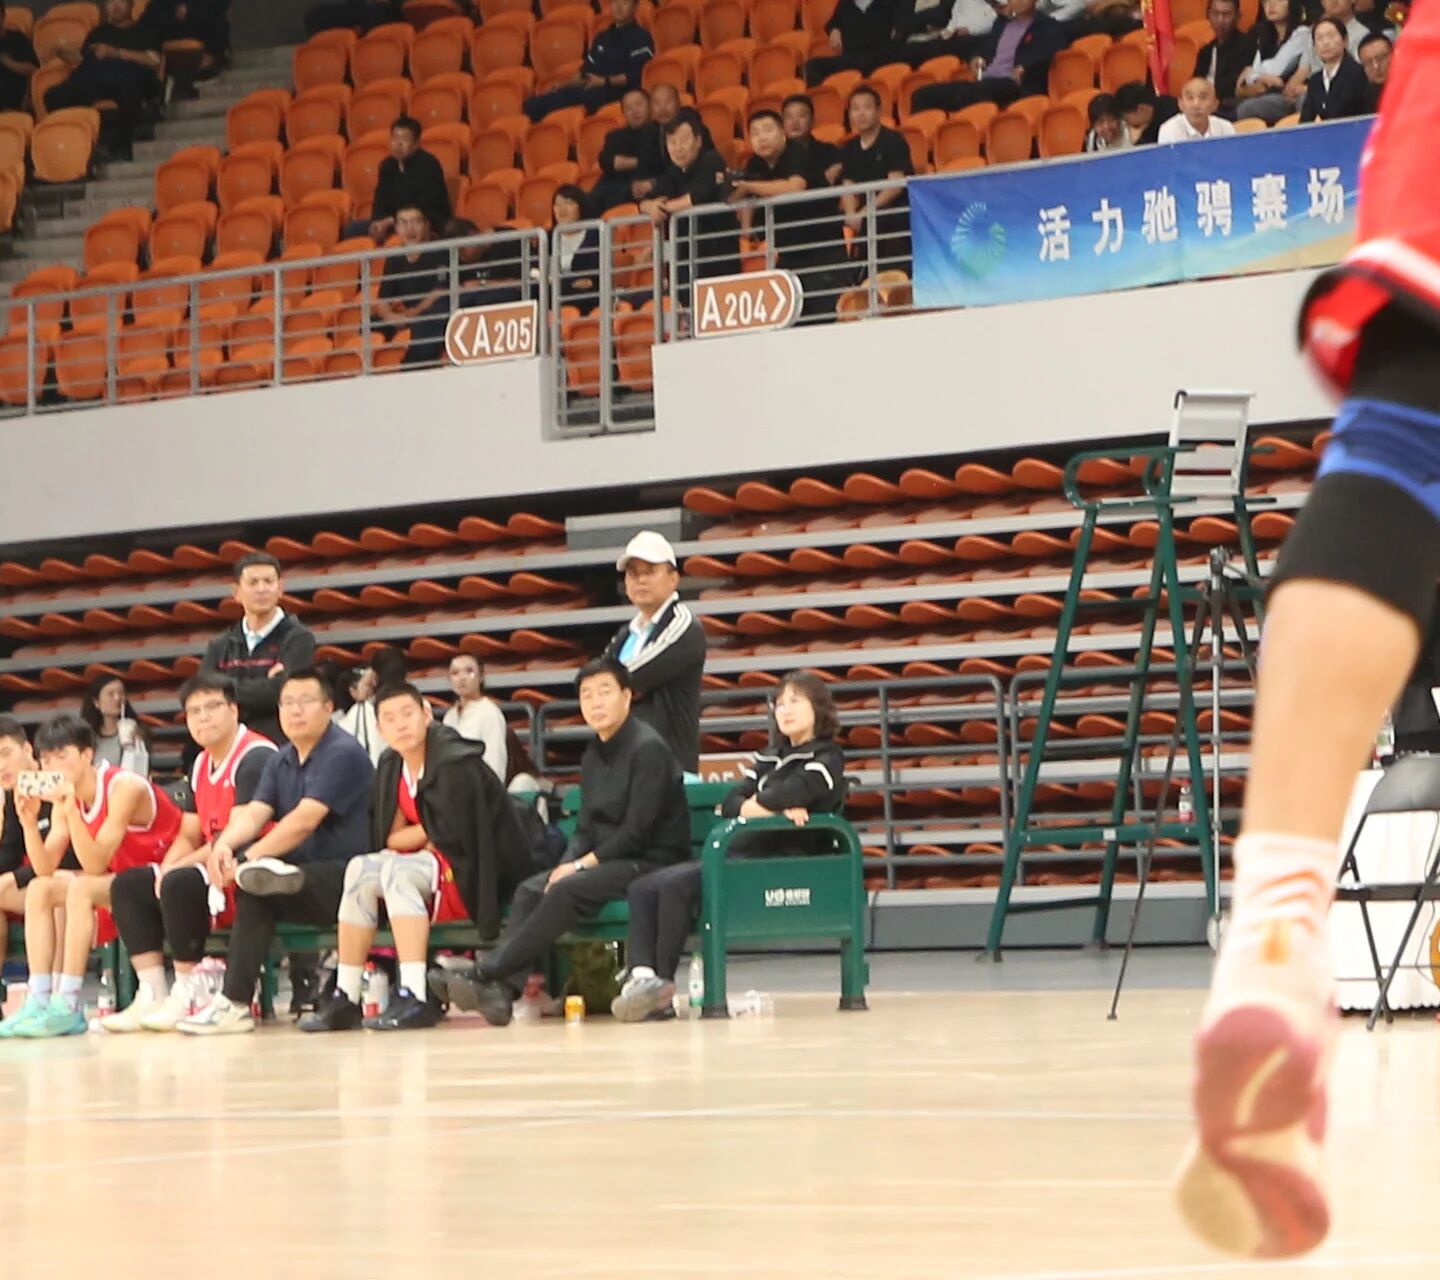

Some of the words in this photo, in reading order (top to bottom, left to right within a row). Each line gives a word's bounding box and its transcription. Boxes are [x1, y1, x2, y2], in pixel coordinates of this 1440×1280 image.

[1037, 166, 1347, 263] 活力驰骋赛场
[701, 286, 767, 330] A204
[471, 314, 532, 357] A205
